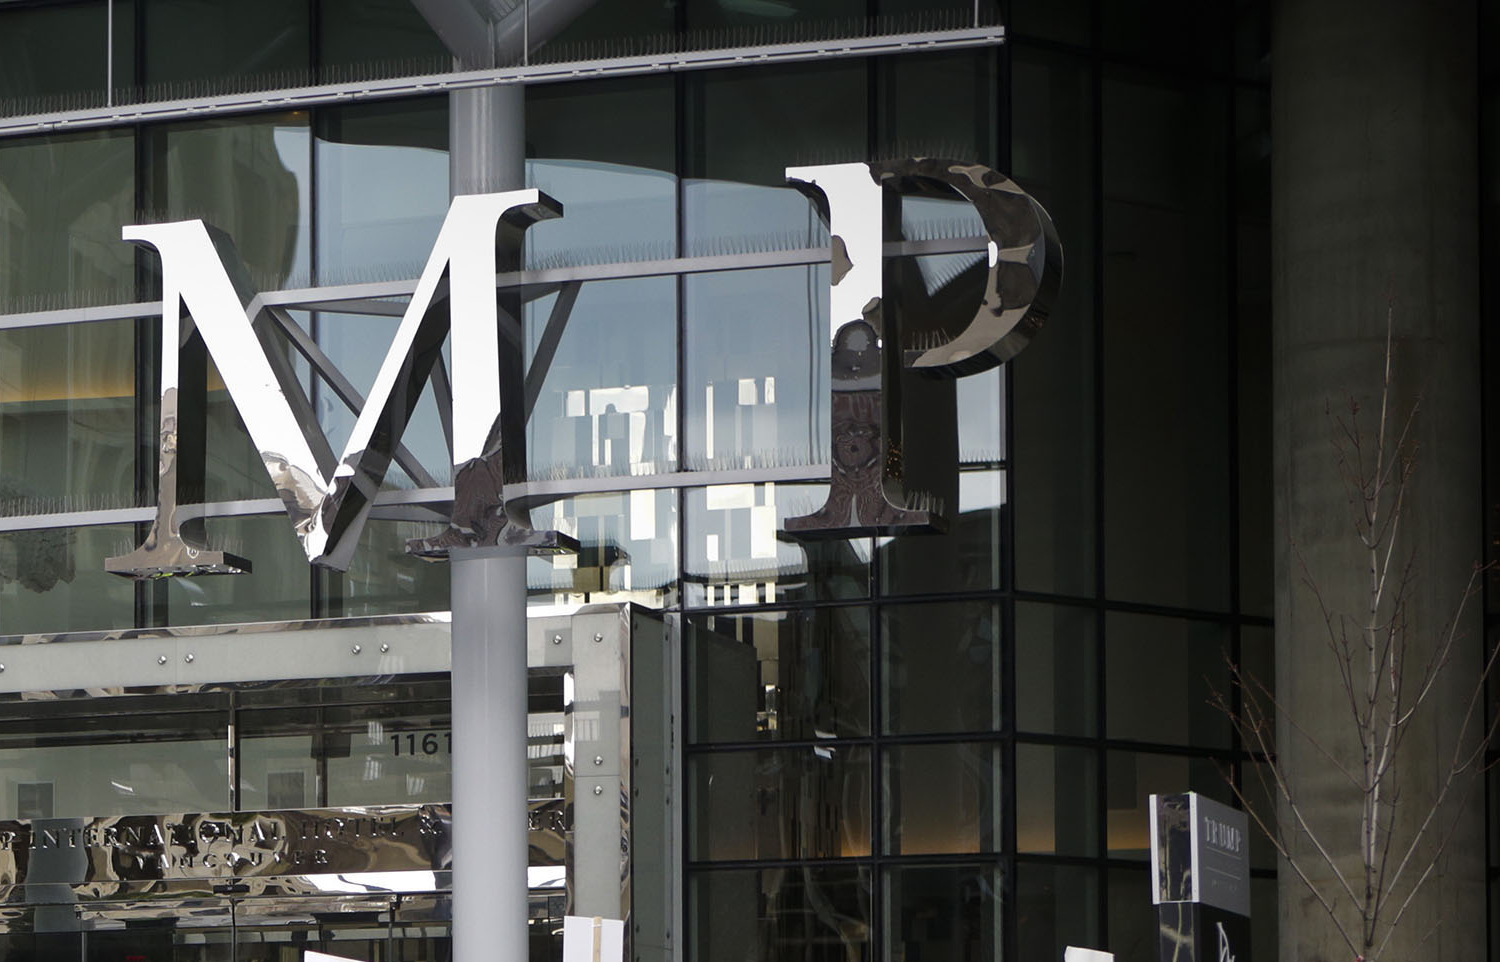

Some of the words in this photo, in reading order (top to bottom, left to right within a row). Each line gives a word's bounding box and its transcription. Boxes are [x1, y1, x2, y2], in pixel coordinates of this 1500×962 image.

[391, 732, 452, 756] 1161
[29, 820, 286, 850] INTERNATIONAL
[1205, 816, 1241, 852] TRUMP
